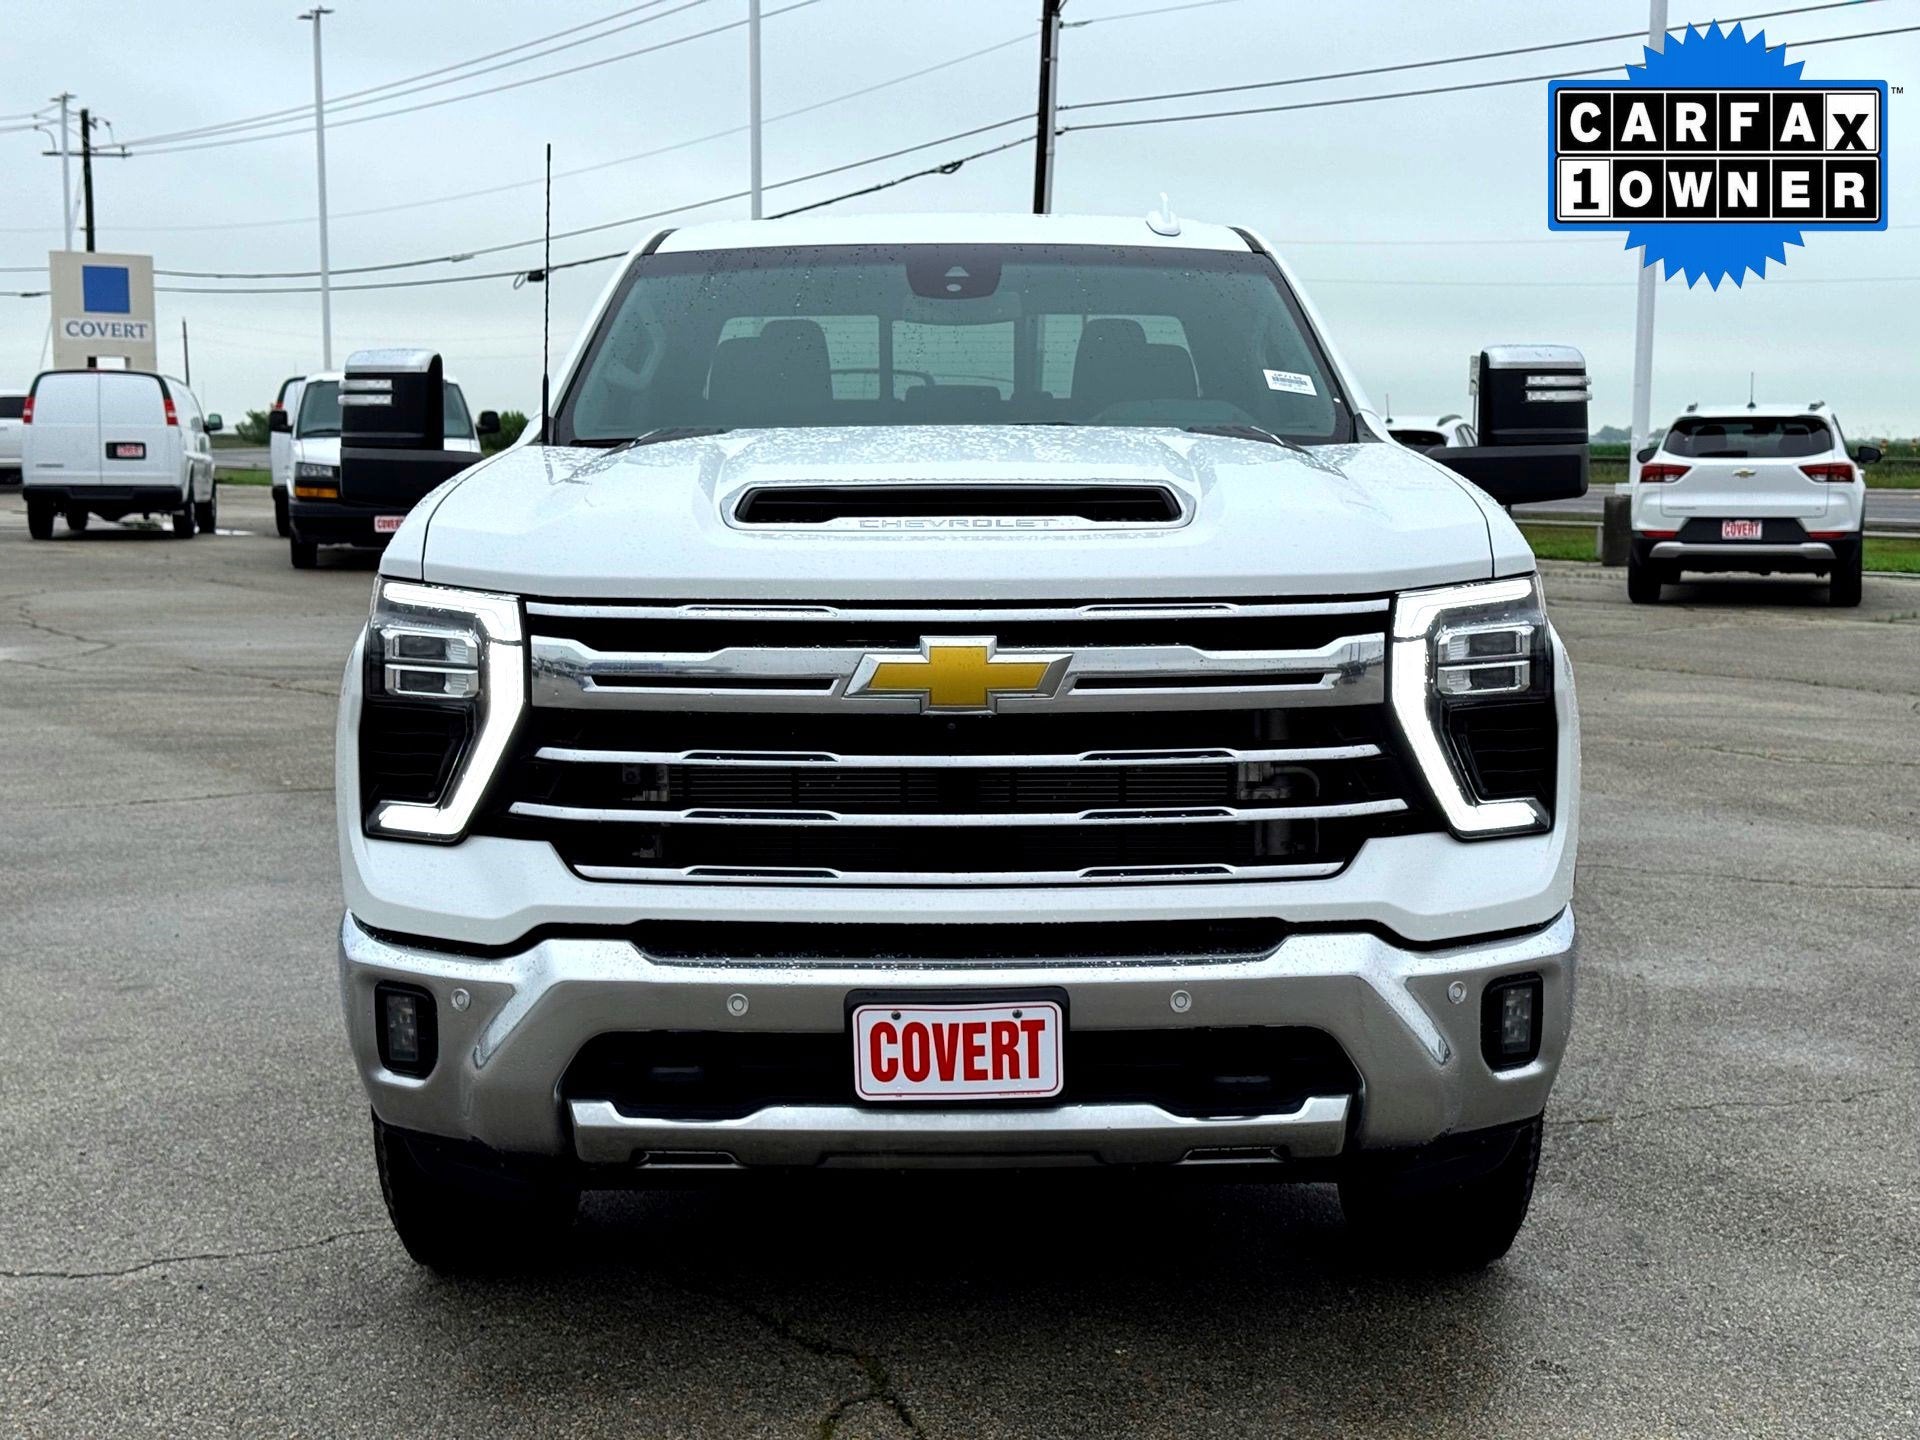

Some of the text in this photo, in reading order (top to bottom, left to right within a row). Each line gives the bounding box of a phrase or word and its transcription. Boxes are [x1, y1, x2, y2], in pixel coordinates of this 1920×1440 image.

[65, 320, 148, 338] COVERT
[859, 518, 1057, 529] CHEVROLET
[1724, 521, 1761, 536] COVERT
[869, 1018, 1046, 1083] COVERT
